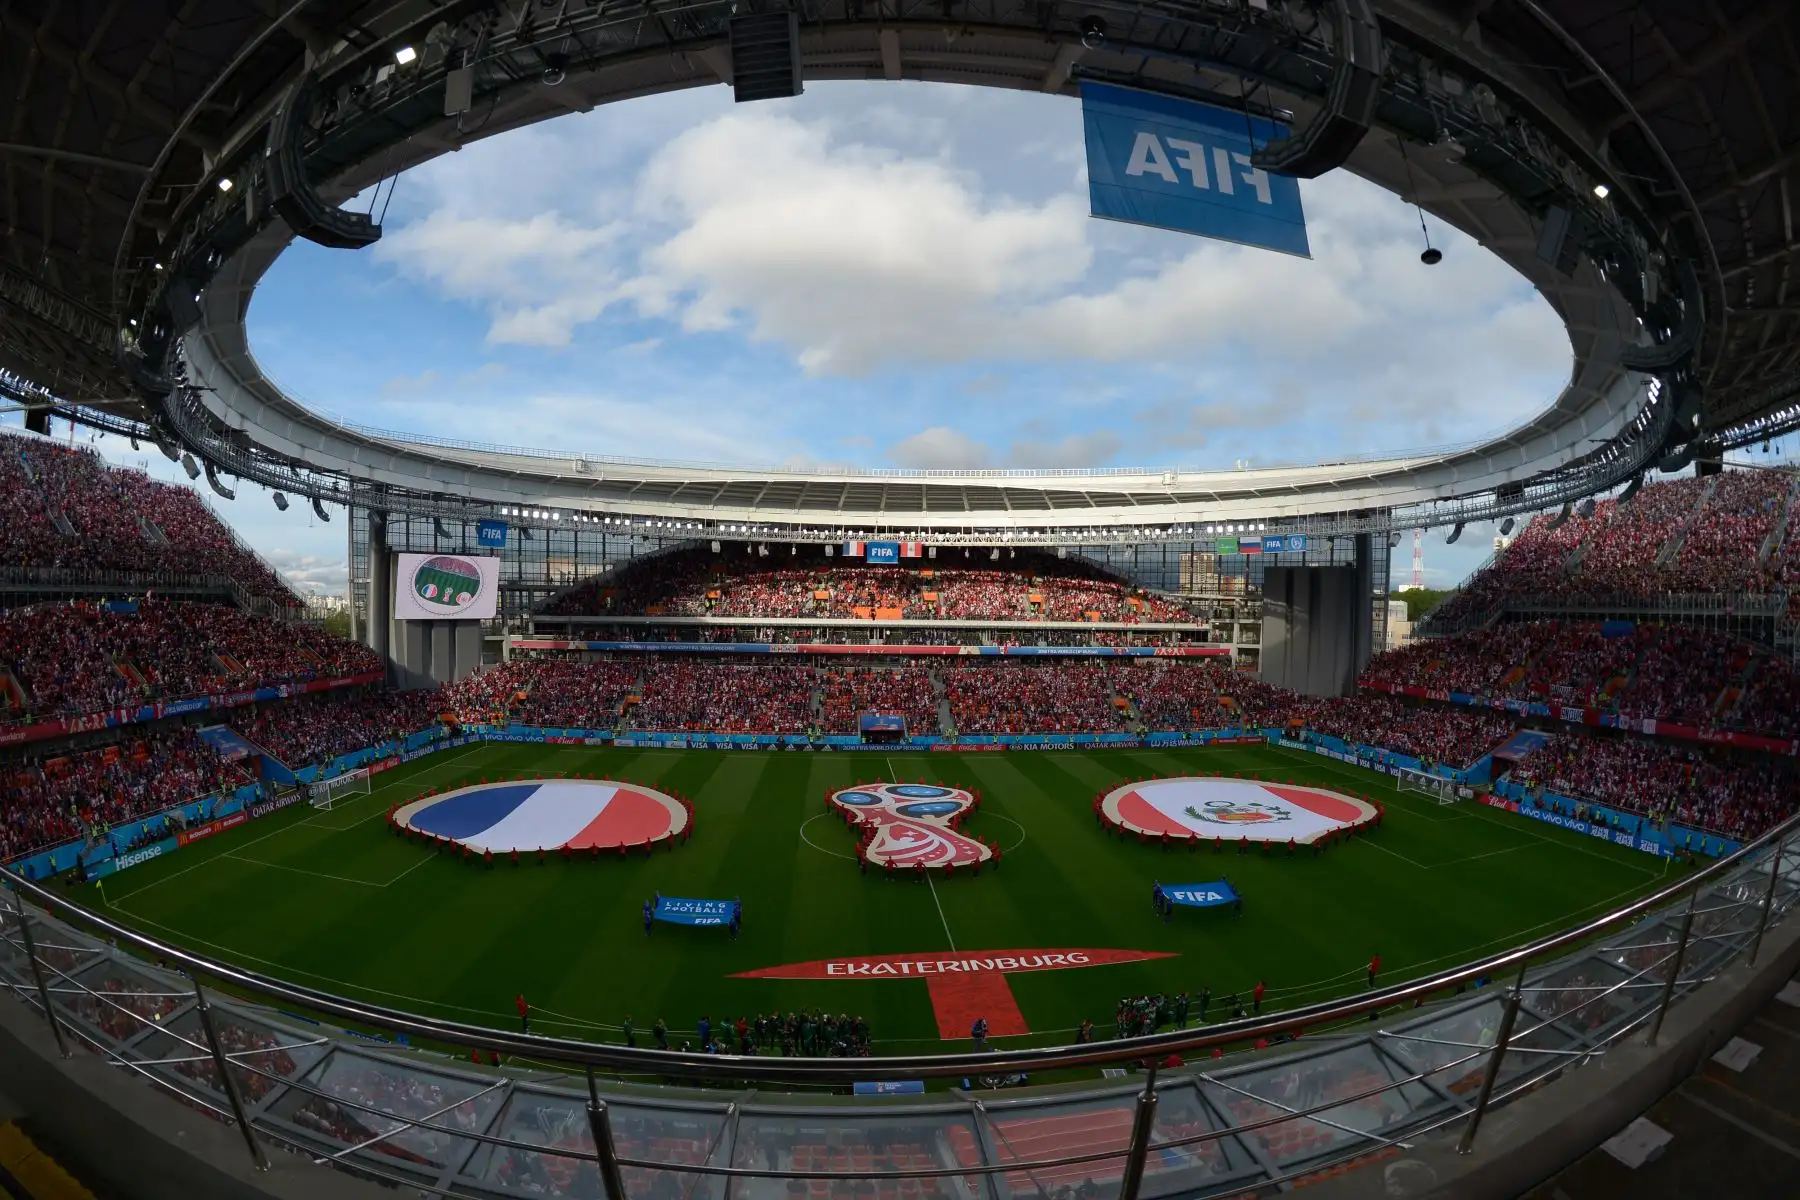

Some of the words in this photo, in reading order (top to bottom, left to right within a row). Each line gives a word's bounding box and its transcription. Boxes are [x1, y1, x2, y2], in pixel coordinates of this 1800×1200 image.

[482, 528, 502, 540] FIFA
[1266, 540, 1281, 548] FIFA
[871, 548, 894, 557] FIFA
[252, 801, 275, 819] QATAR
[275, 792, 302, 811] AIRWAYS
[1488, 795, 1508, 809] Bud
[1521, 806, 1540, 818] vivo
[1542, 812, 1562, 824] vivo
[1564, 818, 1585, 831] vivo
[115, 845, 162, 871] Hisense
[1173, 891, 1224, 902] FIFA
[827, 952, 1090, 975] EKATERINBURG
